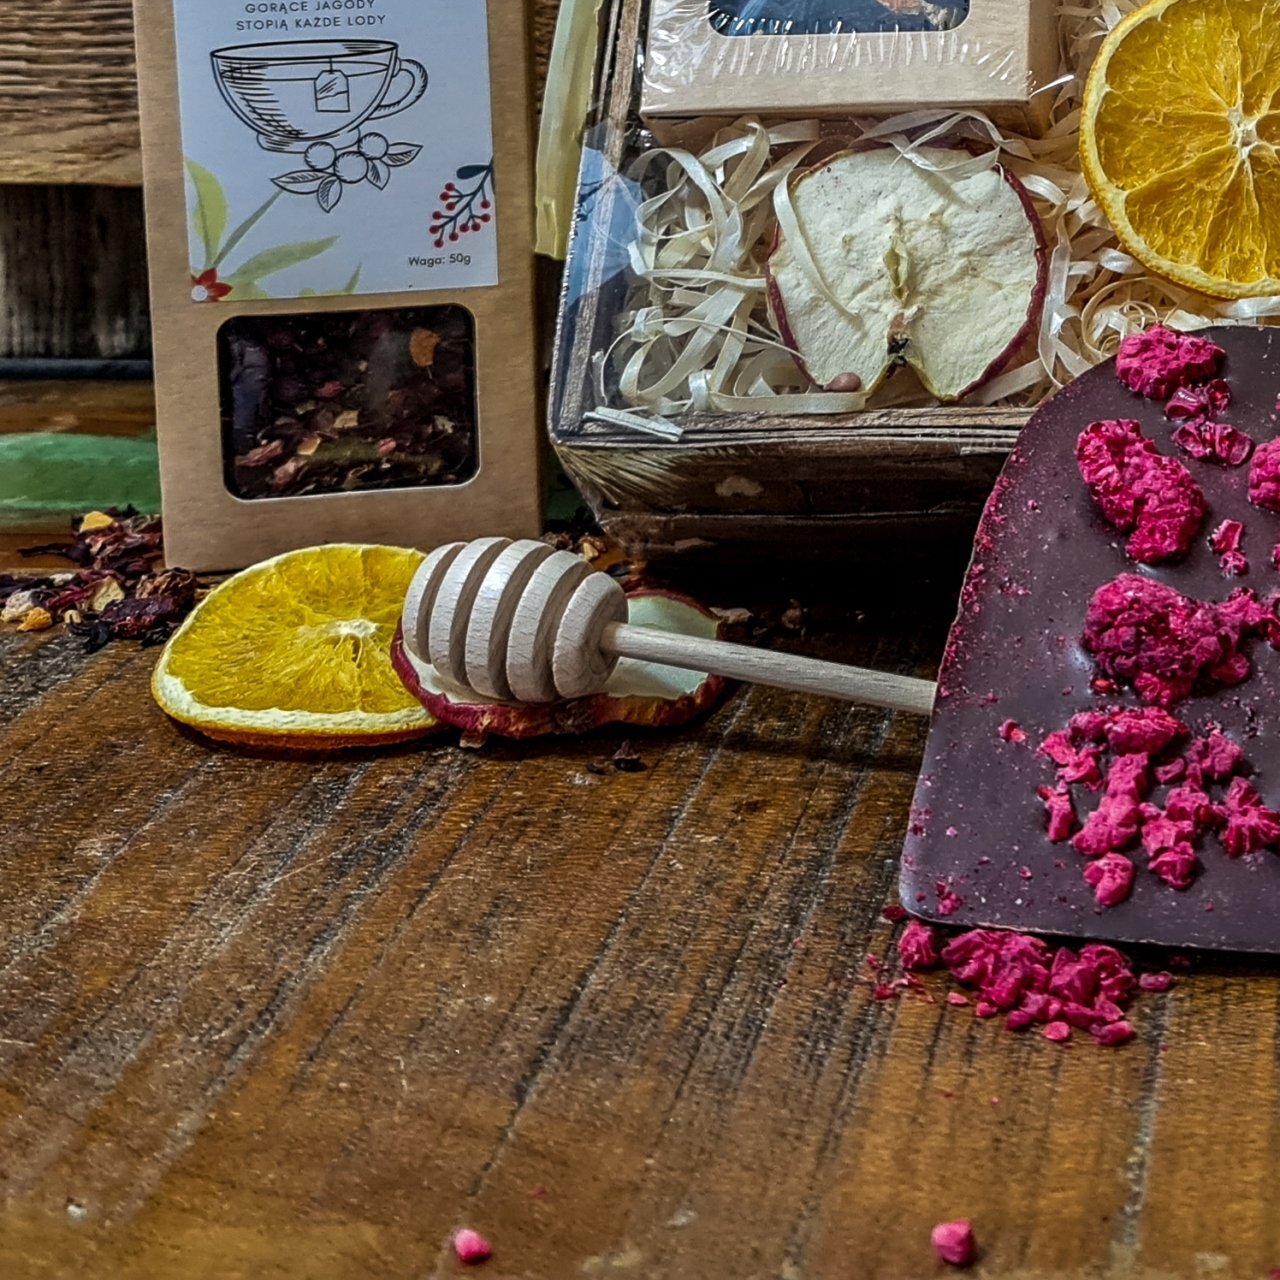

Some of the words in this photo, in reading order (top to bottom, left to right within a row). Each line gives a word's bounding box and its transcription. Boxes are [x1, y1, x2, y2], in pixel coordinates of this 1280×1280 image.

[244, 1, 309, 15] GORĄCE
[315, 0, 376, 11] JAGODY
[236, 19, 289, 32] STOPIĄ
[295, 16, 342, 29] KAŻDE
[347, 14, 387, 27] LODY
[407, 256, 446, 269] Waga:
[448, 253, 472, 267] 50g
